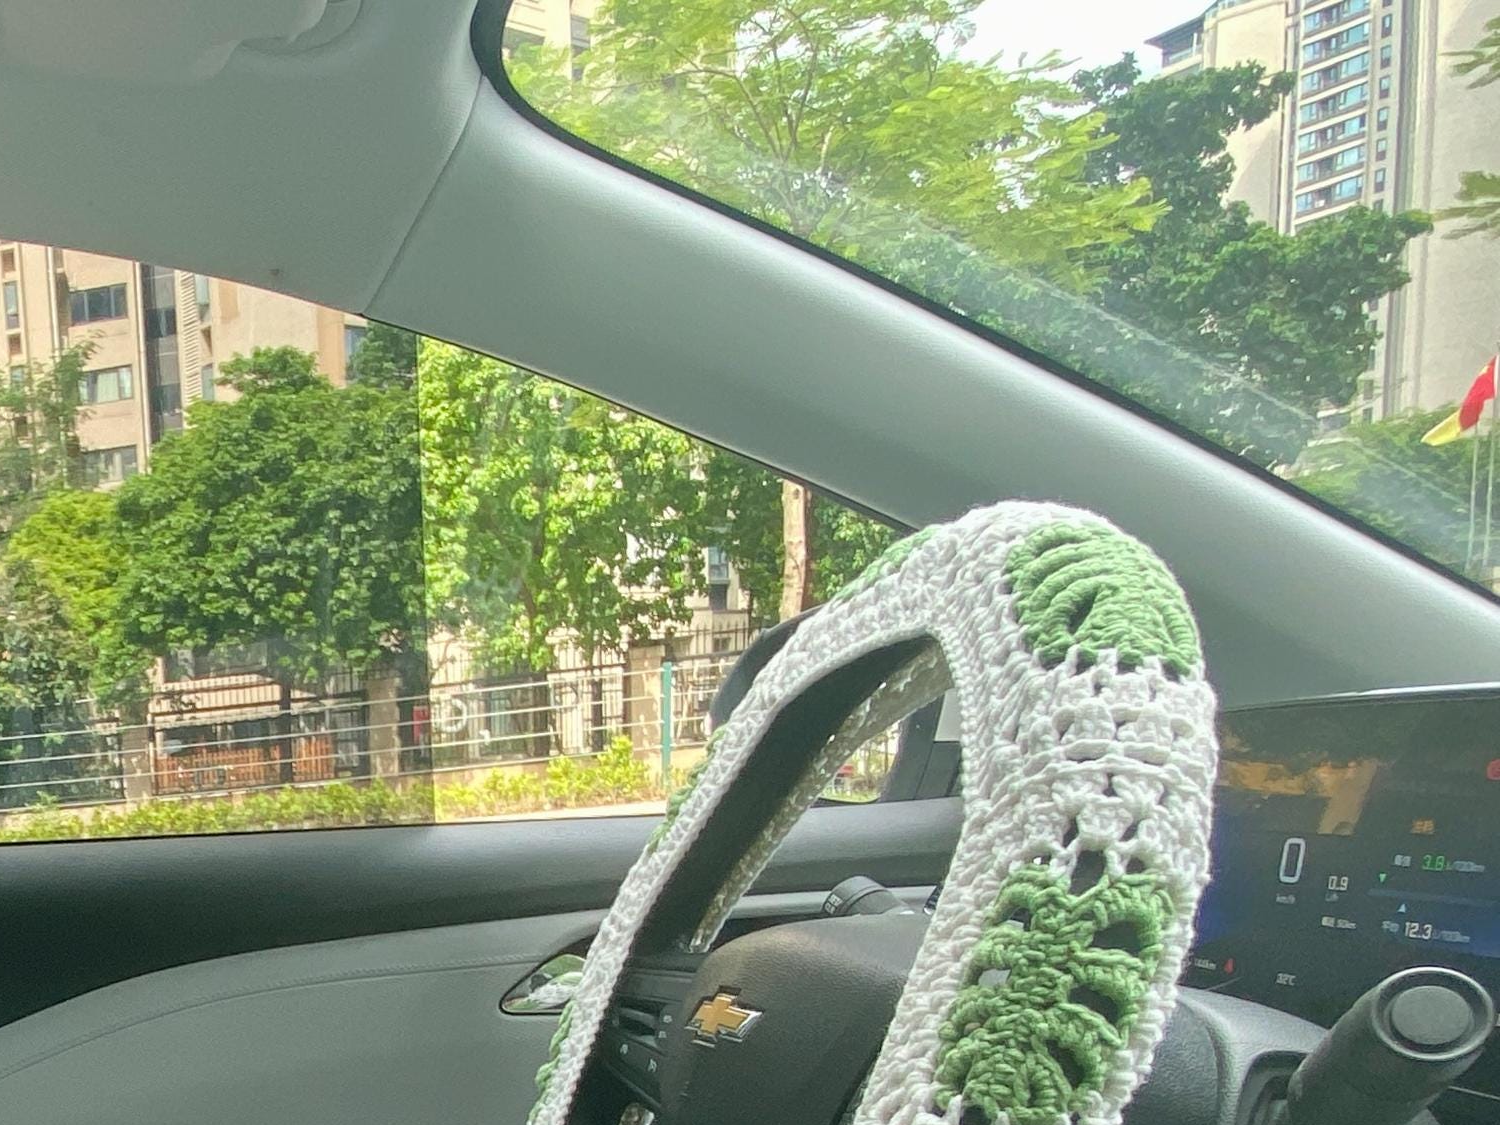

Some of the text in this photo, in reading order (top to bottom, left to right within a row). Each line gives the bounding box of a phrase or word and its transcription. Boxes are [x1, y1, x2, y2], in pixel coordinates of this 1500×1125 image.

[1279, 837, 1306, 883] 0
[1328, 875, 1349, 891] 0.9
[1405, 921, 1433, 940] 12.3
